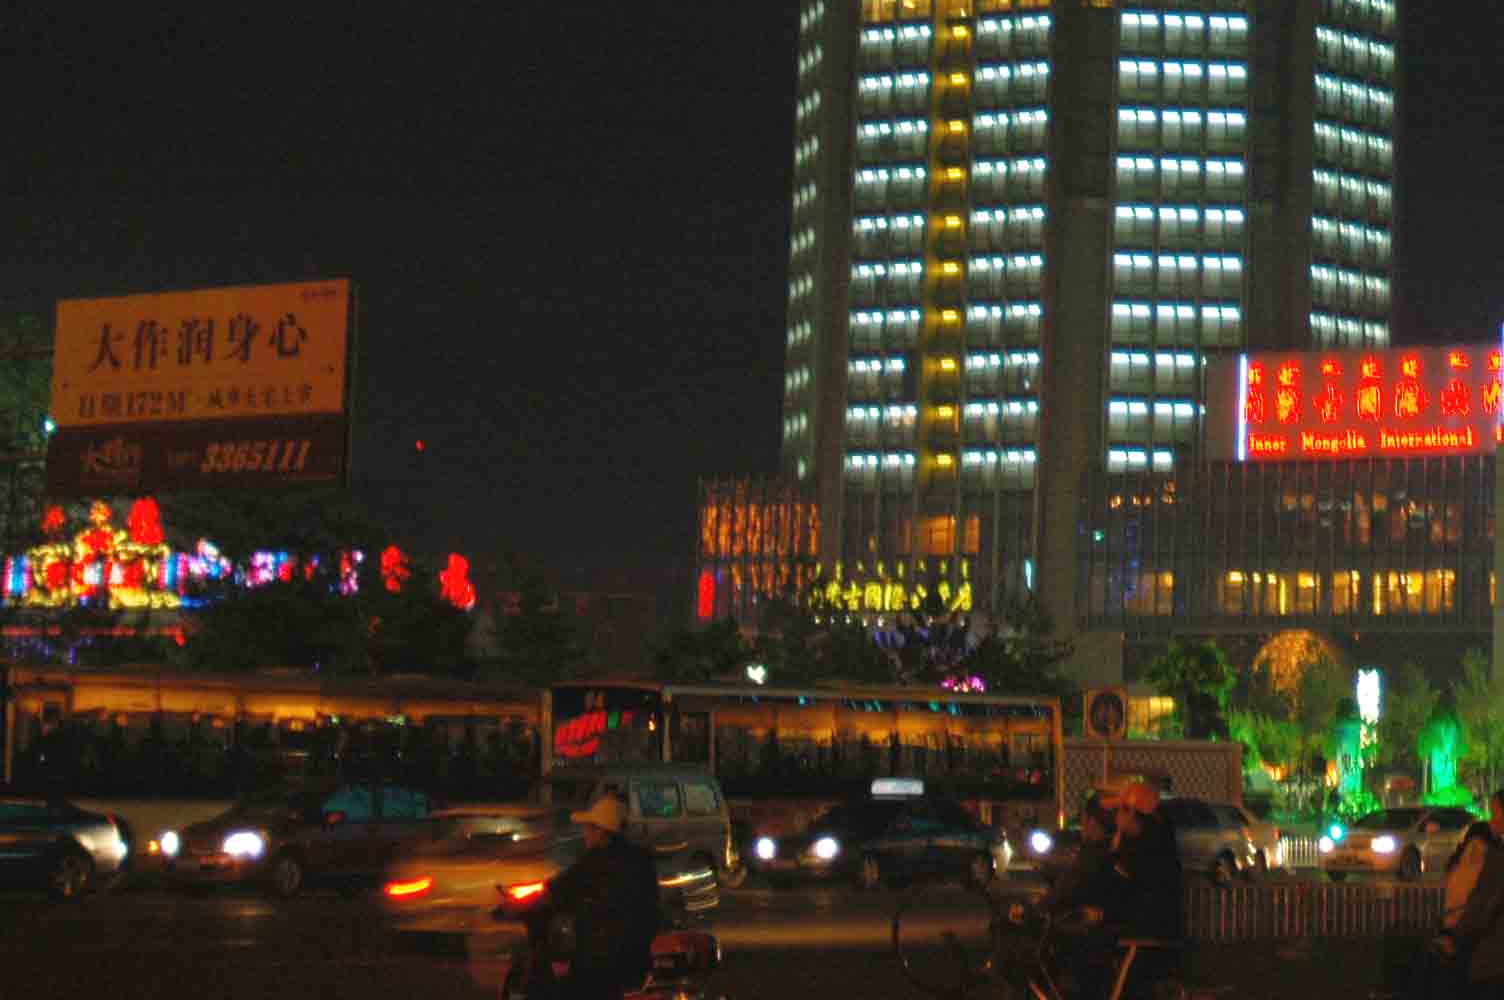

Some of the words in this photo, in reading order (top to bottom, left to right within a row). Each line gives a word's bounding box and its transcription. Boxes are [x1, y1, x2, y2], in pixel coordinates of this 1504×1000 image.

[1248, 432, 1287, 452] Inner
[1301, 427, 1369, 454] Mongolia
[1380, 423, 1474, 450] International
